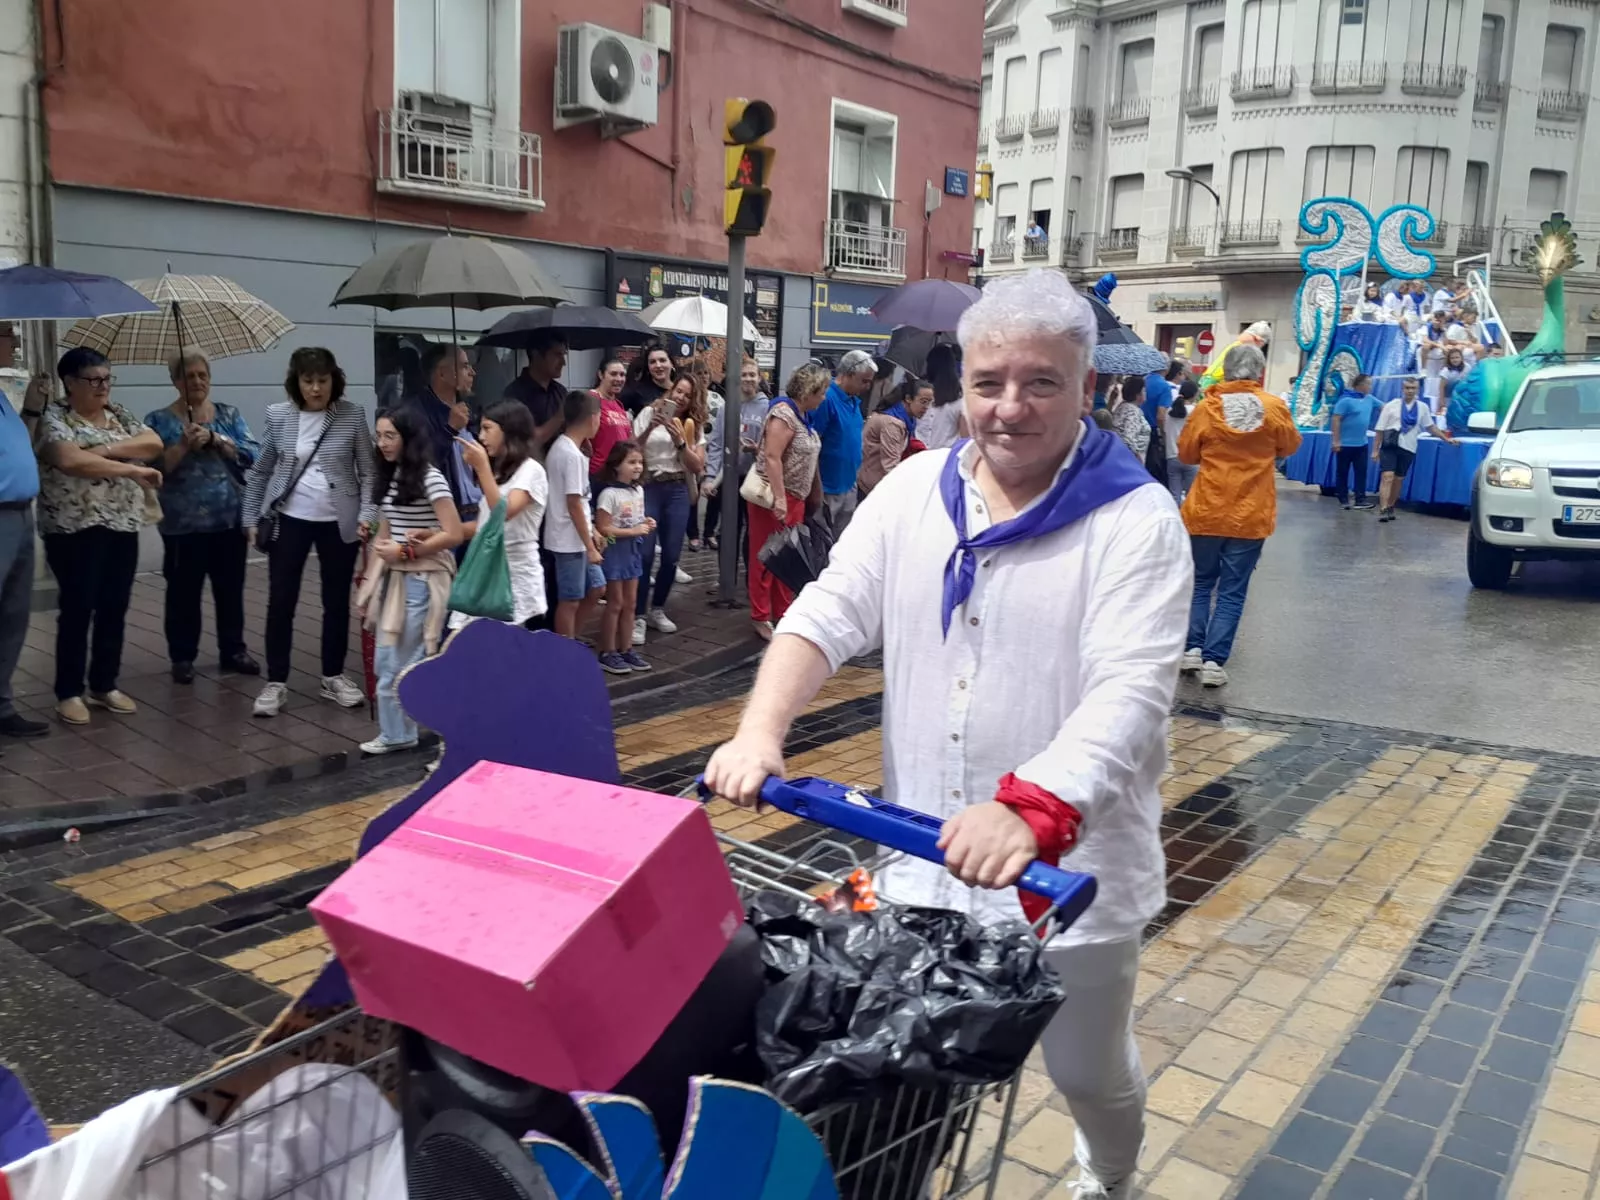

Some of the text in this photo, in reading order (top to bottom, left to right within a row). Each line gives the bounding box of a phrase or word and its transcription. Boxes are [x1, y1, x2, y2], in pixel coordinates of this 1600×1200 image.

[640, 74, 652, 87] LG
[663, 271, 708, 288] AYUNTAMIENTO
[708, 276, 717, 289] DE
